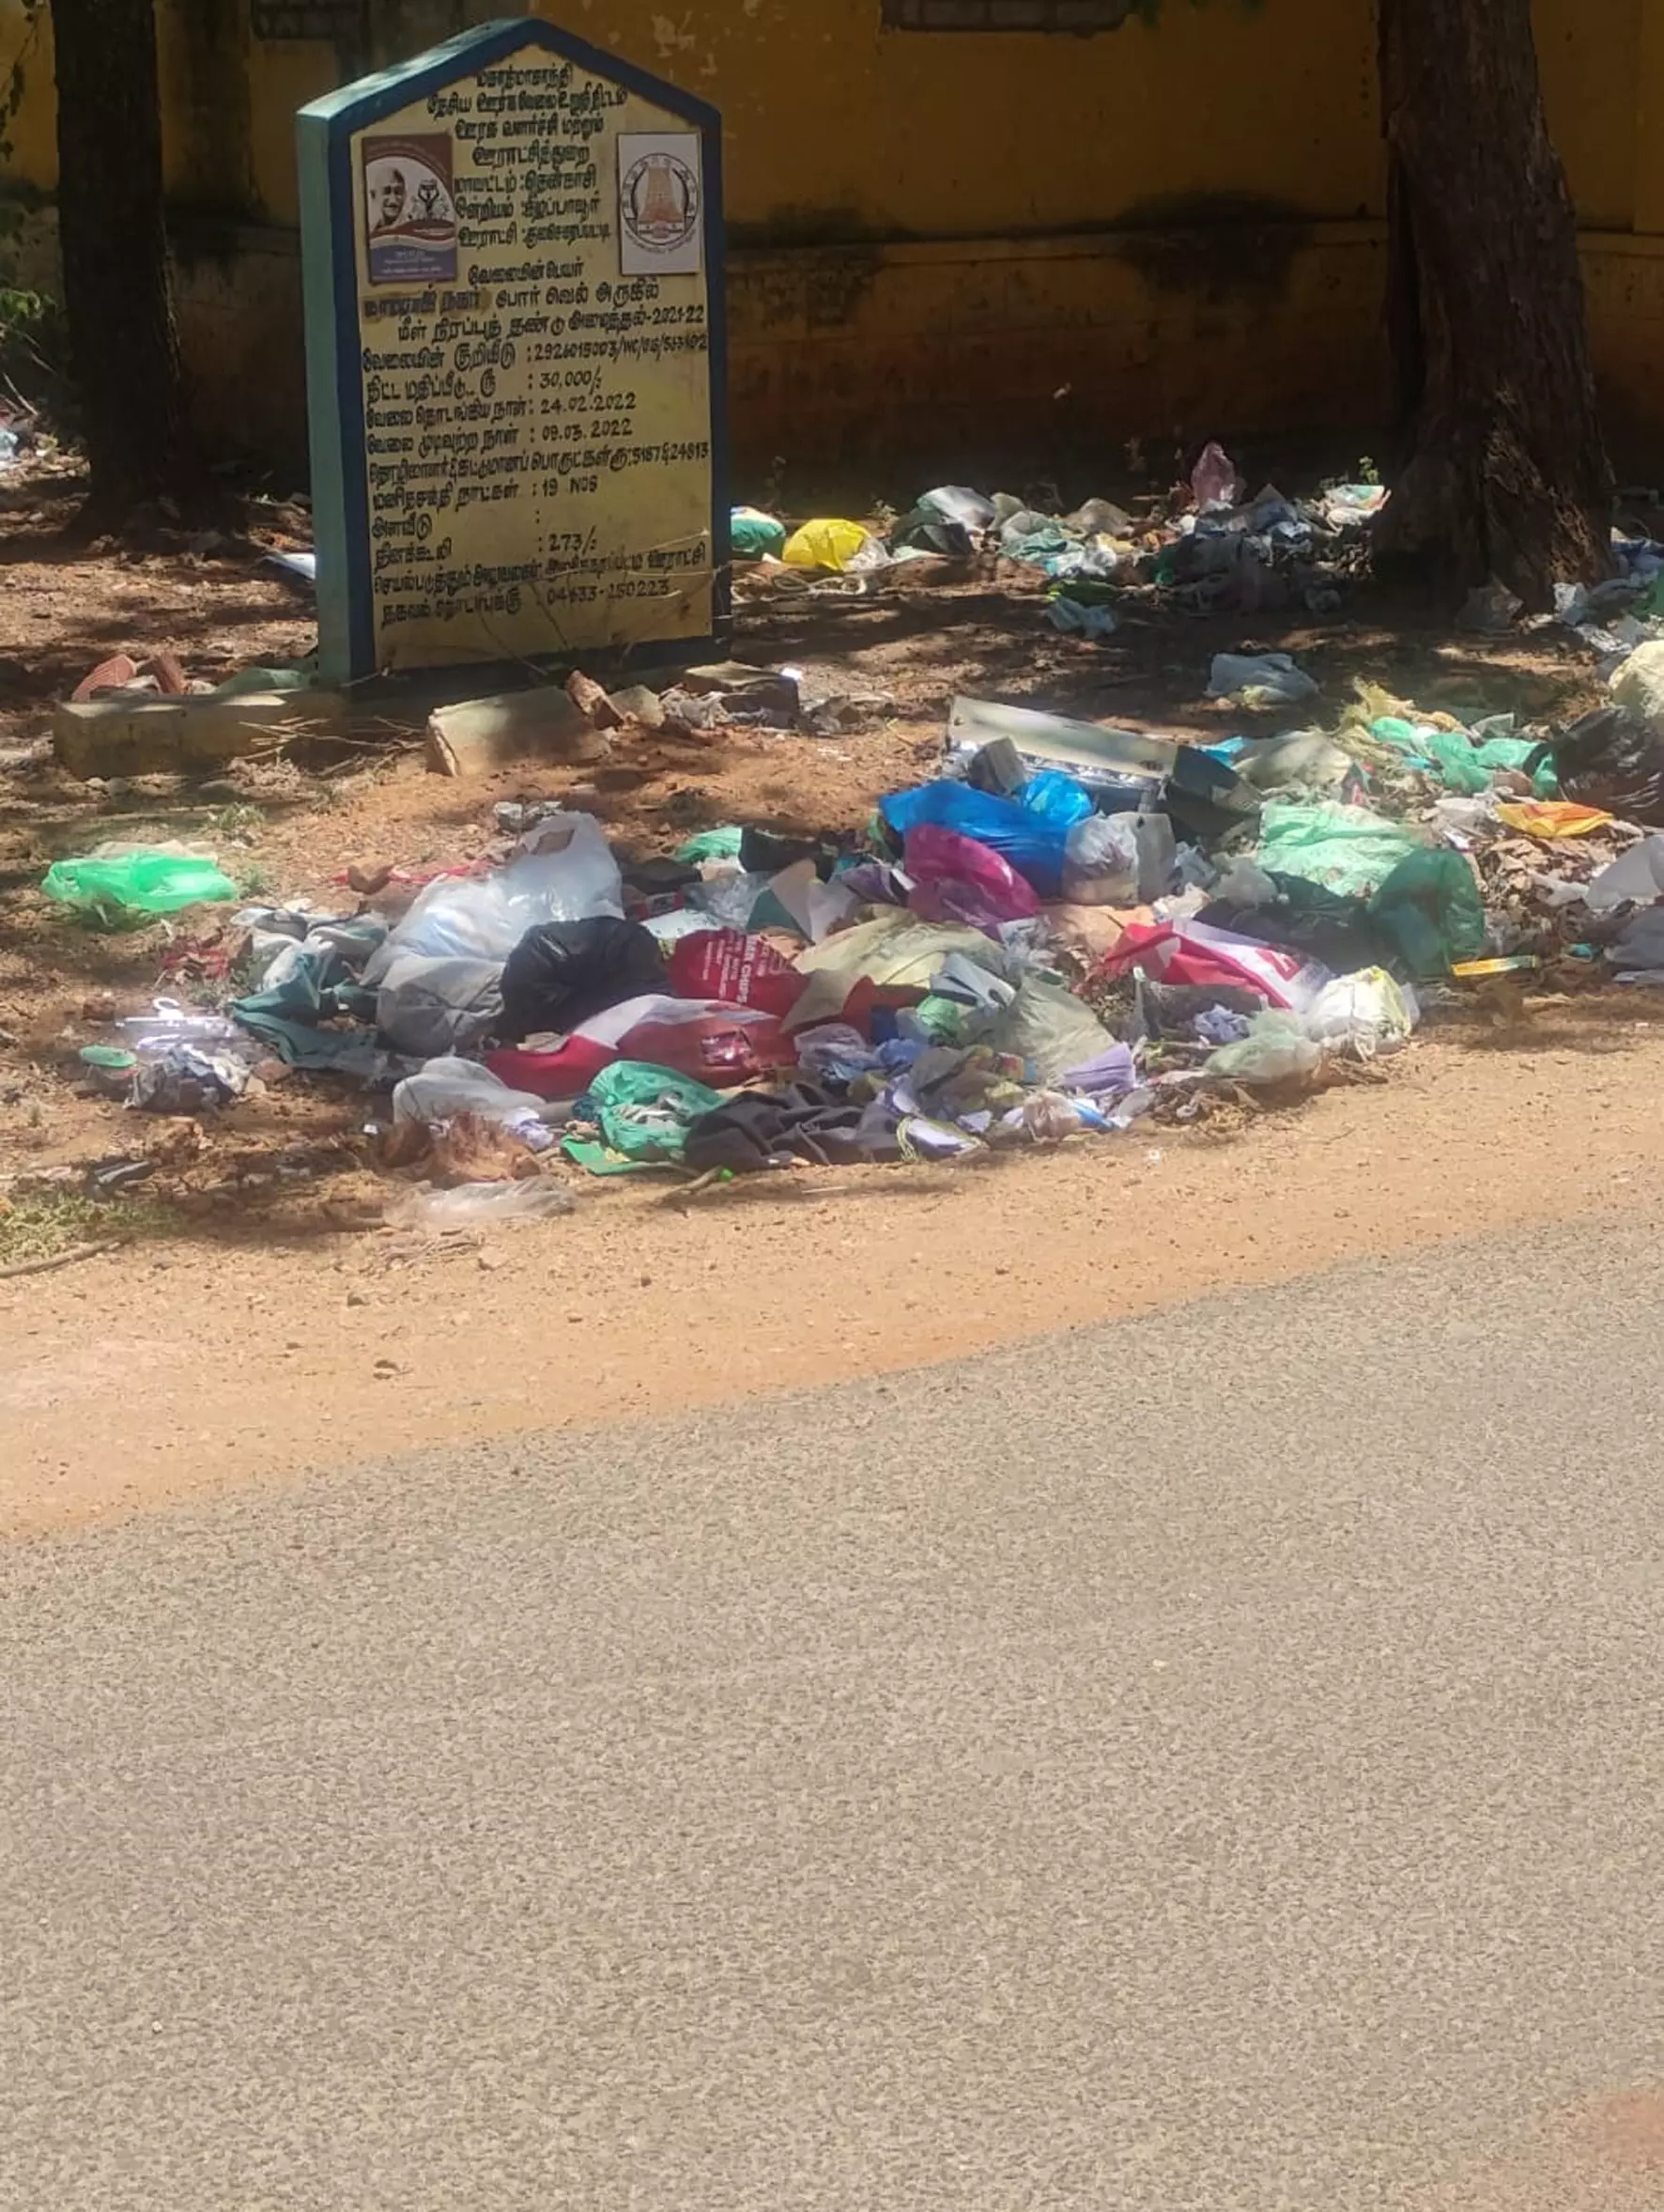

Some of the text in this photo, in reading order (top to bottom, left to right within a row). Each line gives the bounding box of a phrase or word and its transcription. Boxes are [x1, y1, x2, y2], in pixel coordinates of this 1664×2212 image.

[546, 282, 589, 305] வெல்
[454, 340, 516, 372] குறியீடு
[540, 392, 637, 415] 24.02.2022
[542, 477, 559, 498] 19
